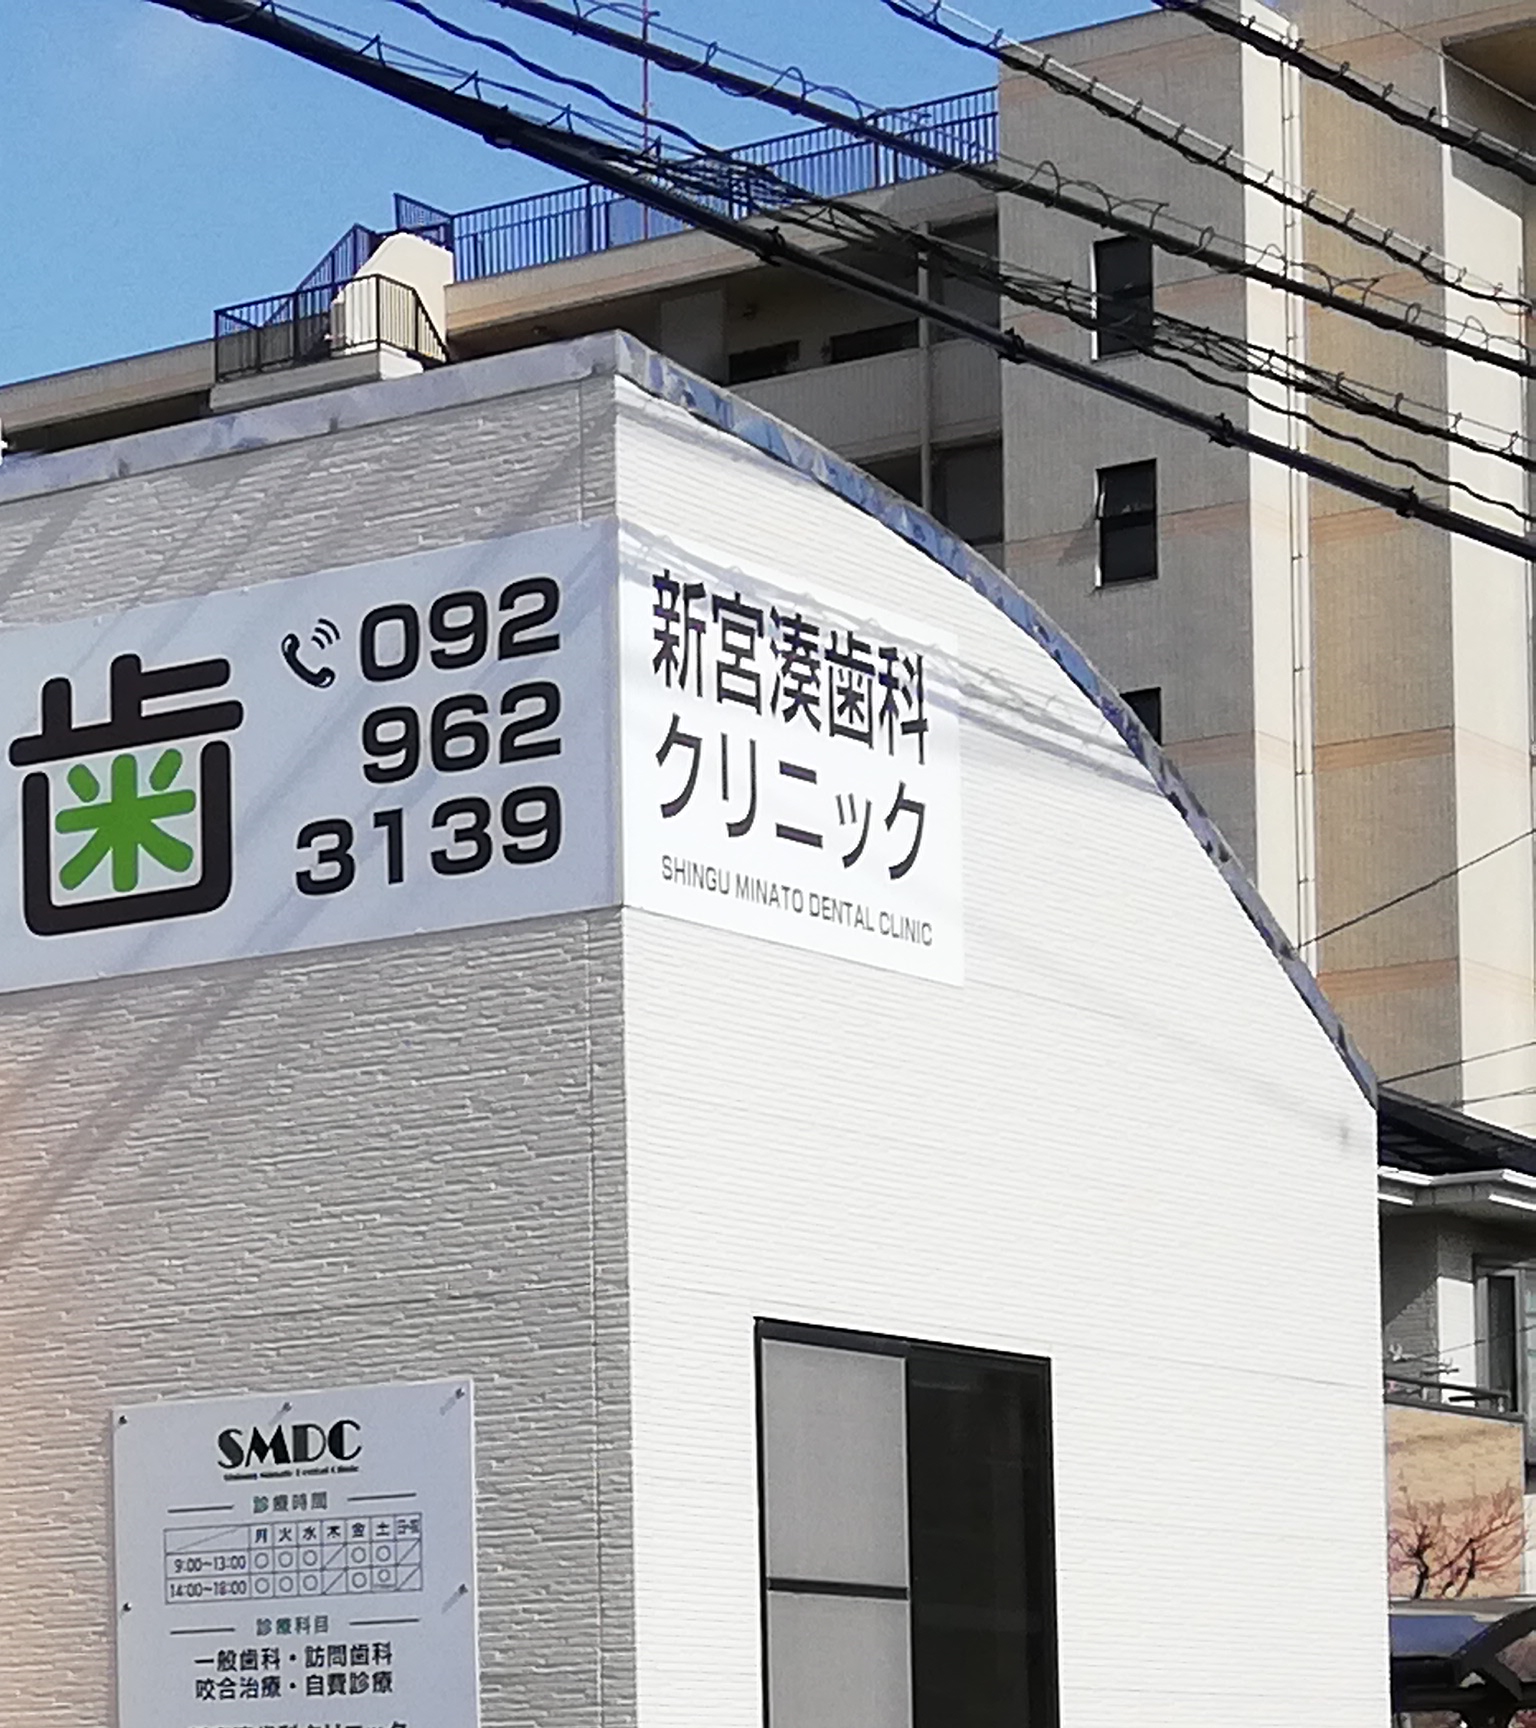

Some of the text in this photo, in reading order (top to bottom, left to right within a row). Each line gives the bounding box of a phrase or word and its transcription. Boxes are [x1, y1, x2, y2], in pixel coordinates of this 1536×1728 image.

[359, 577, 561, 682] 092
[652, 569, 928, 765] 新宮湊歯科
[362, 681, 561, 783] 962
[296, 785, 561, 897] 3139
[655, 713, 925, 880] クリニック
[661, 854, 933, 947] SHINGU MINATO DENTAL CLINIC
[217, 1419, 362, 1469] SMDC
[278, 1526, 292, 1542] 火
[302, 1525, 317, 1541] 水
[375, 1521, 390, 1537] 土
